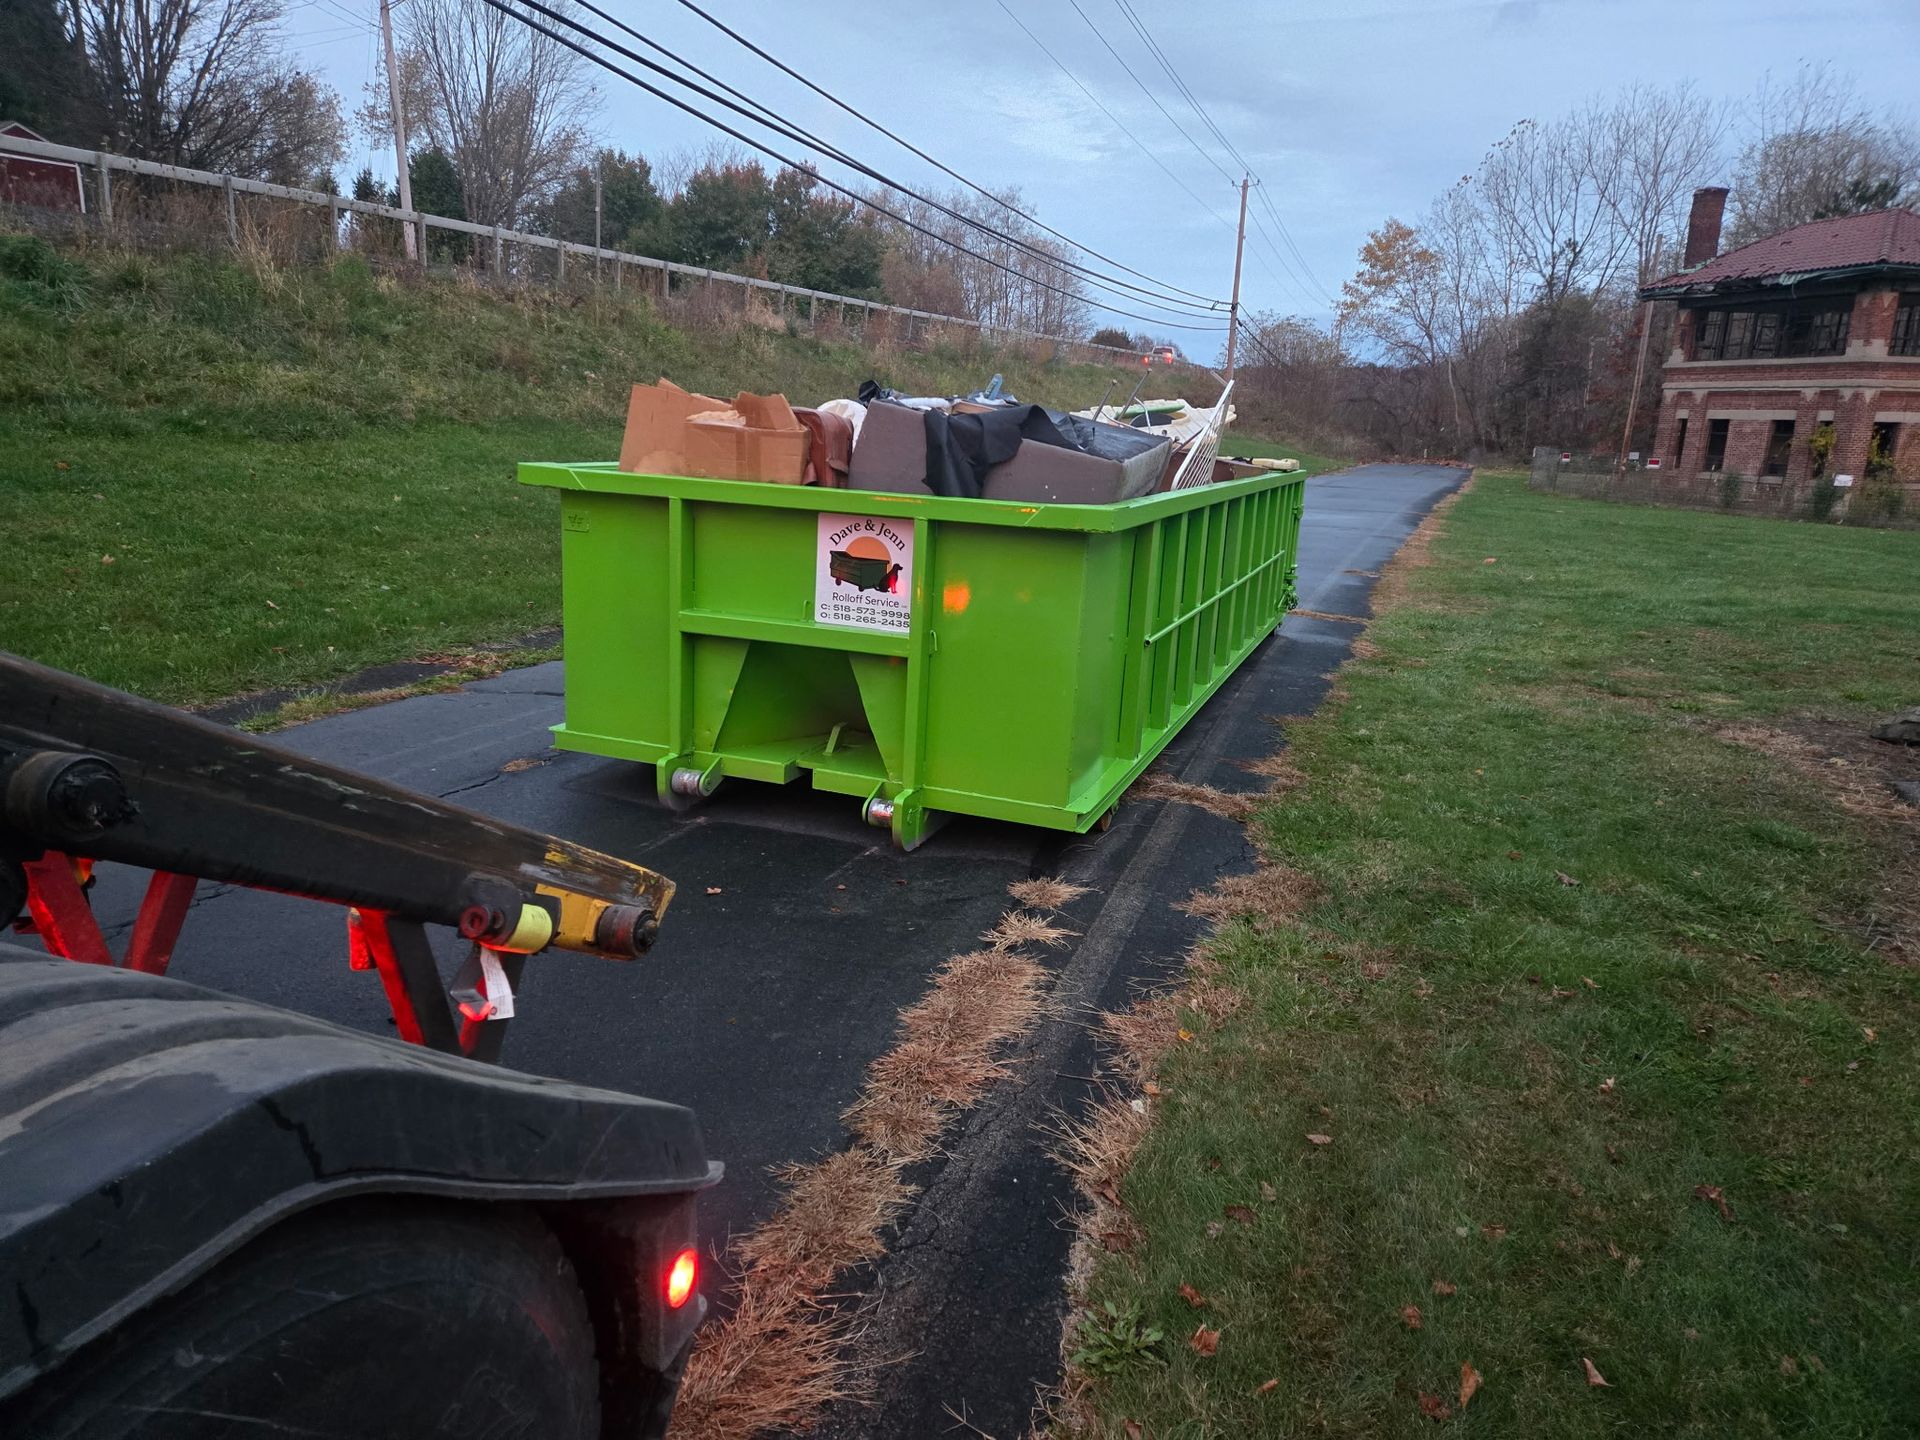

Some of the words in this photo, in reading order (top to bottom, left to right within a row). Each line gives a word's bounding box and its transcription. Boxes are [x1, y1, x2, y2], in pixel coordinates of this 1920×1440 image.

[829, 522, 861, 546] Dave
[865, 519, 875, 532] &
[876, 523, 905, 551] Jenn
[832, 592, 863, 604] Rolloff
[865, 596, 899, 608] Service
[833, 604, 910, 620] 518-573-9998
[833, 613, 910, 628] 518-265-2435
